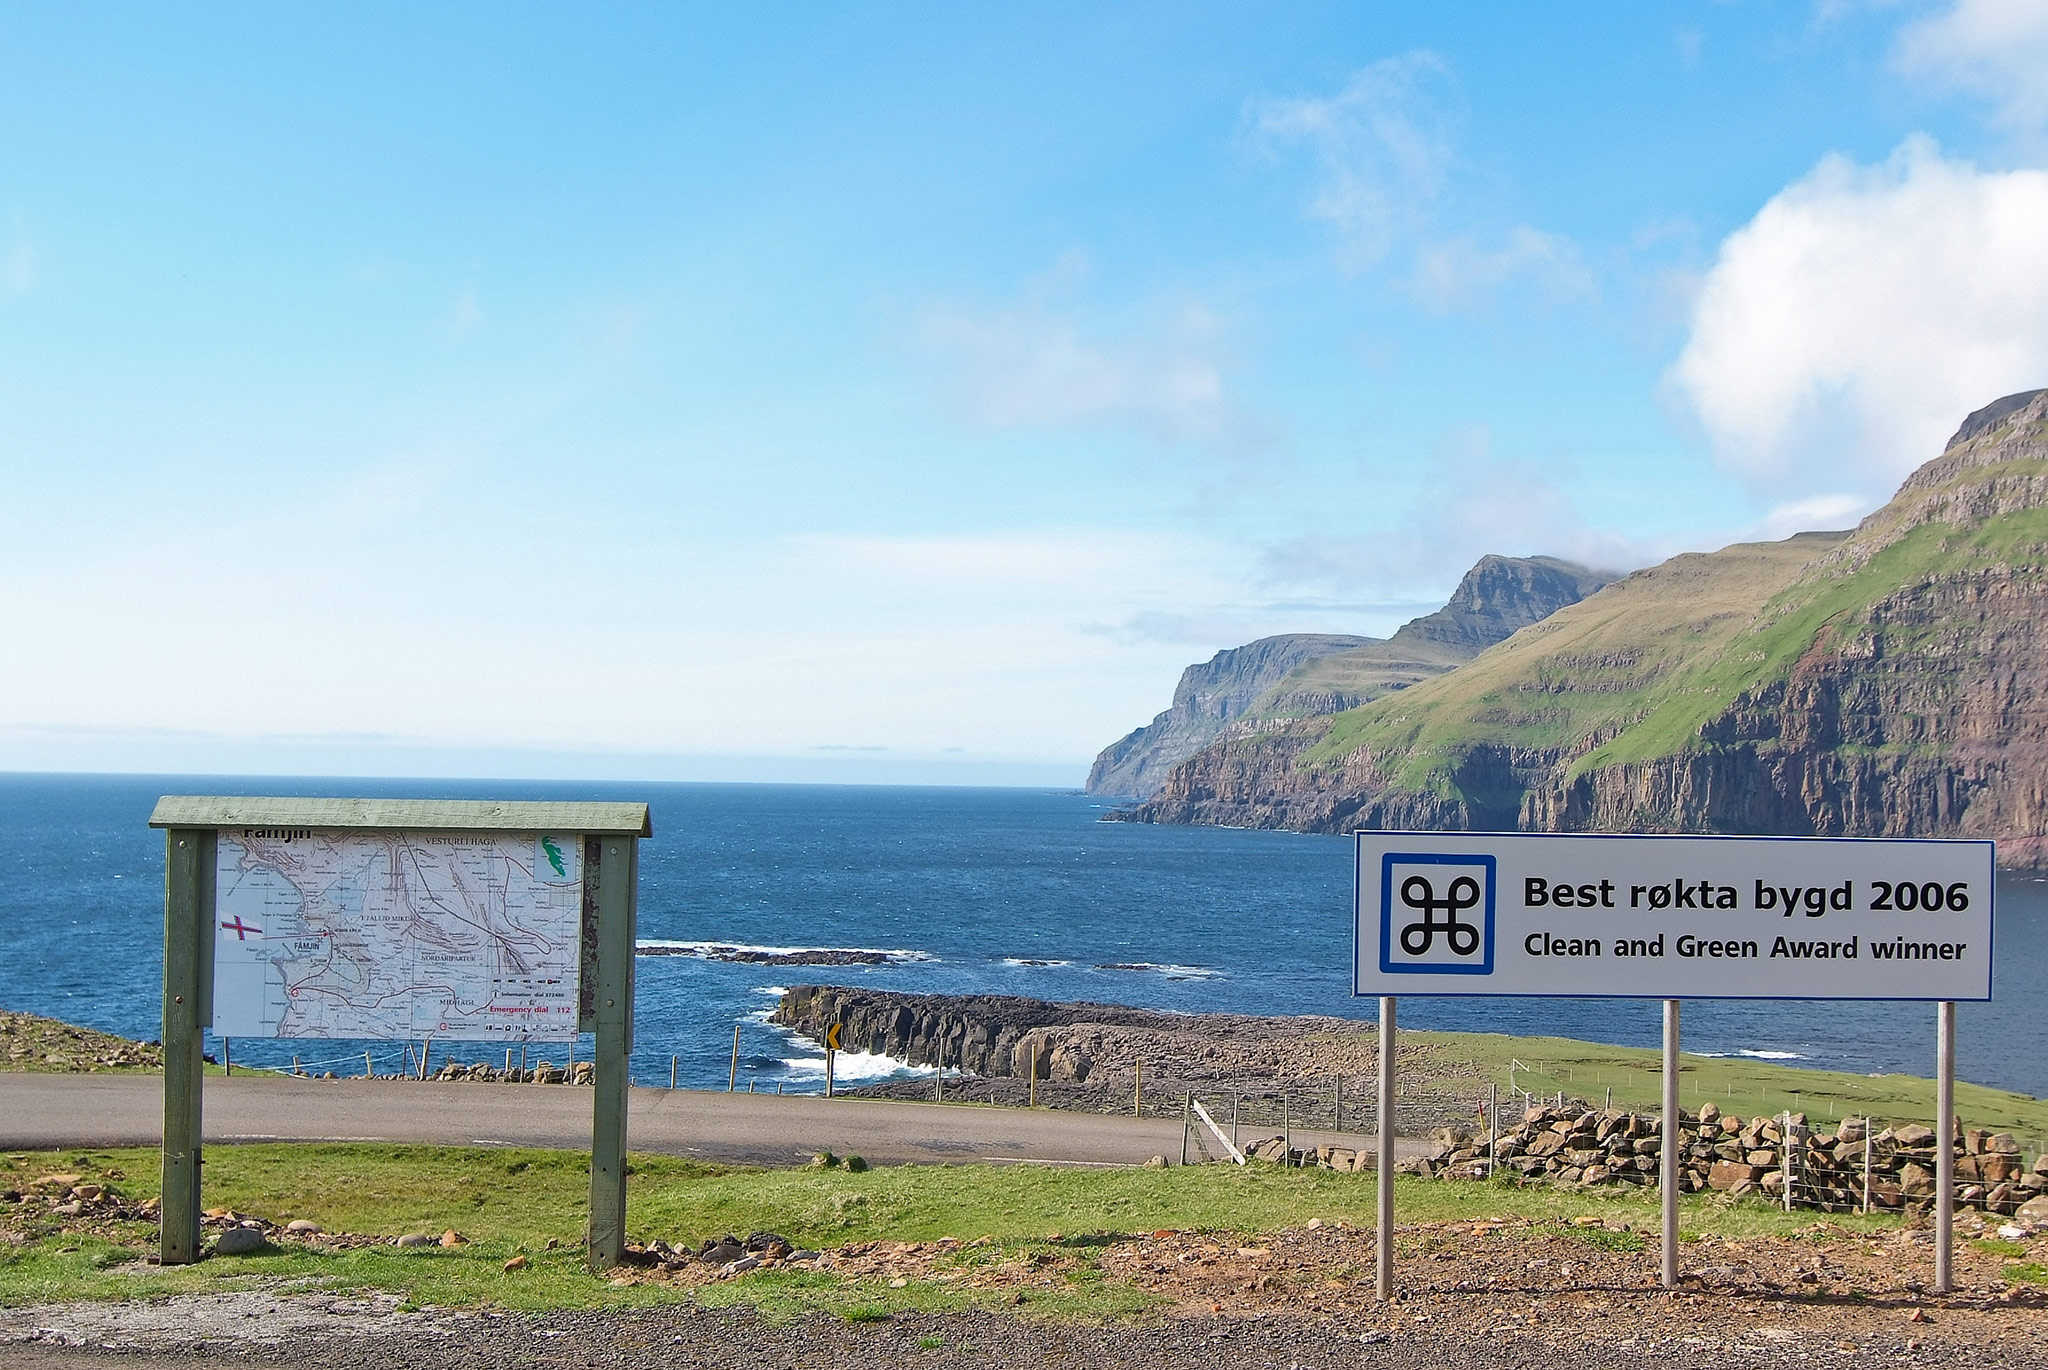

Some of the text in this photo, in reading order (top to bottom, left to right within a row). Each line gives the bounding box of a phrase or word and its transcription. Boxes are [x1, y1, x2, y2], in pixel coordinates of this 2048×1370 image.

[1524, 877, 1969, 918] Best røkta bygd 2006
[1524, 932, 1967, 961] Clean and Green Award winner
[489, 1006, 532, 1014] Emergency
